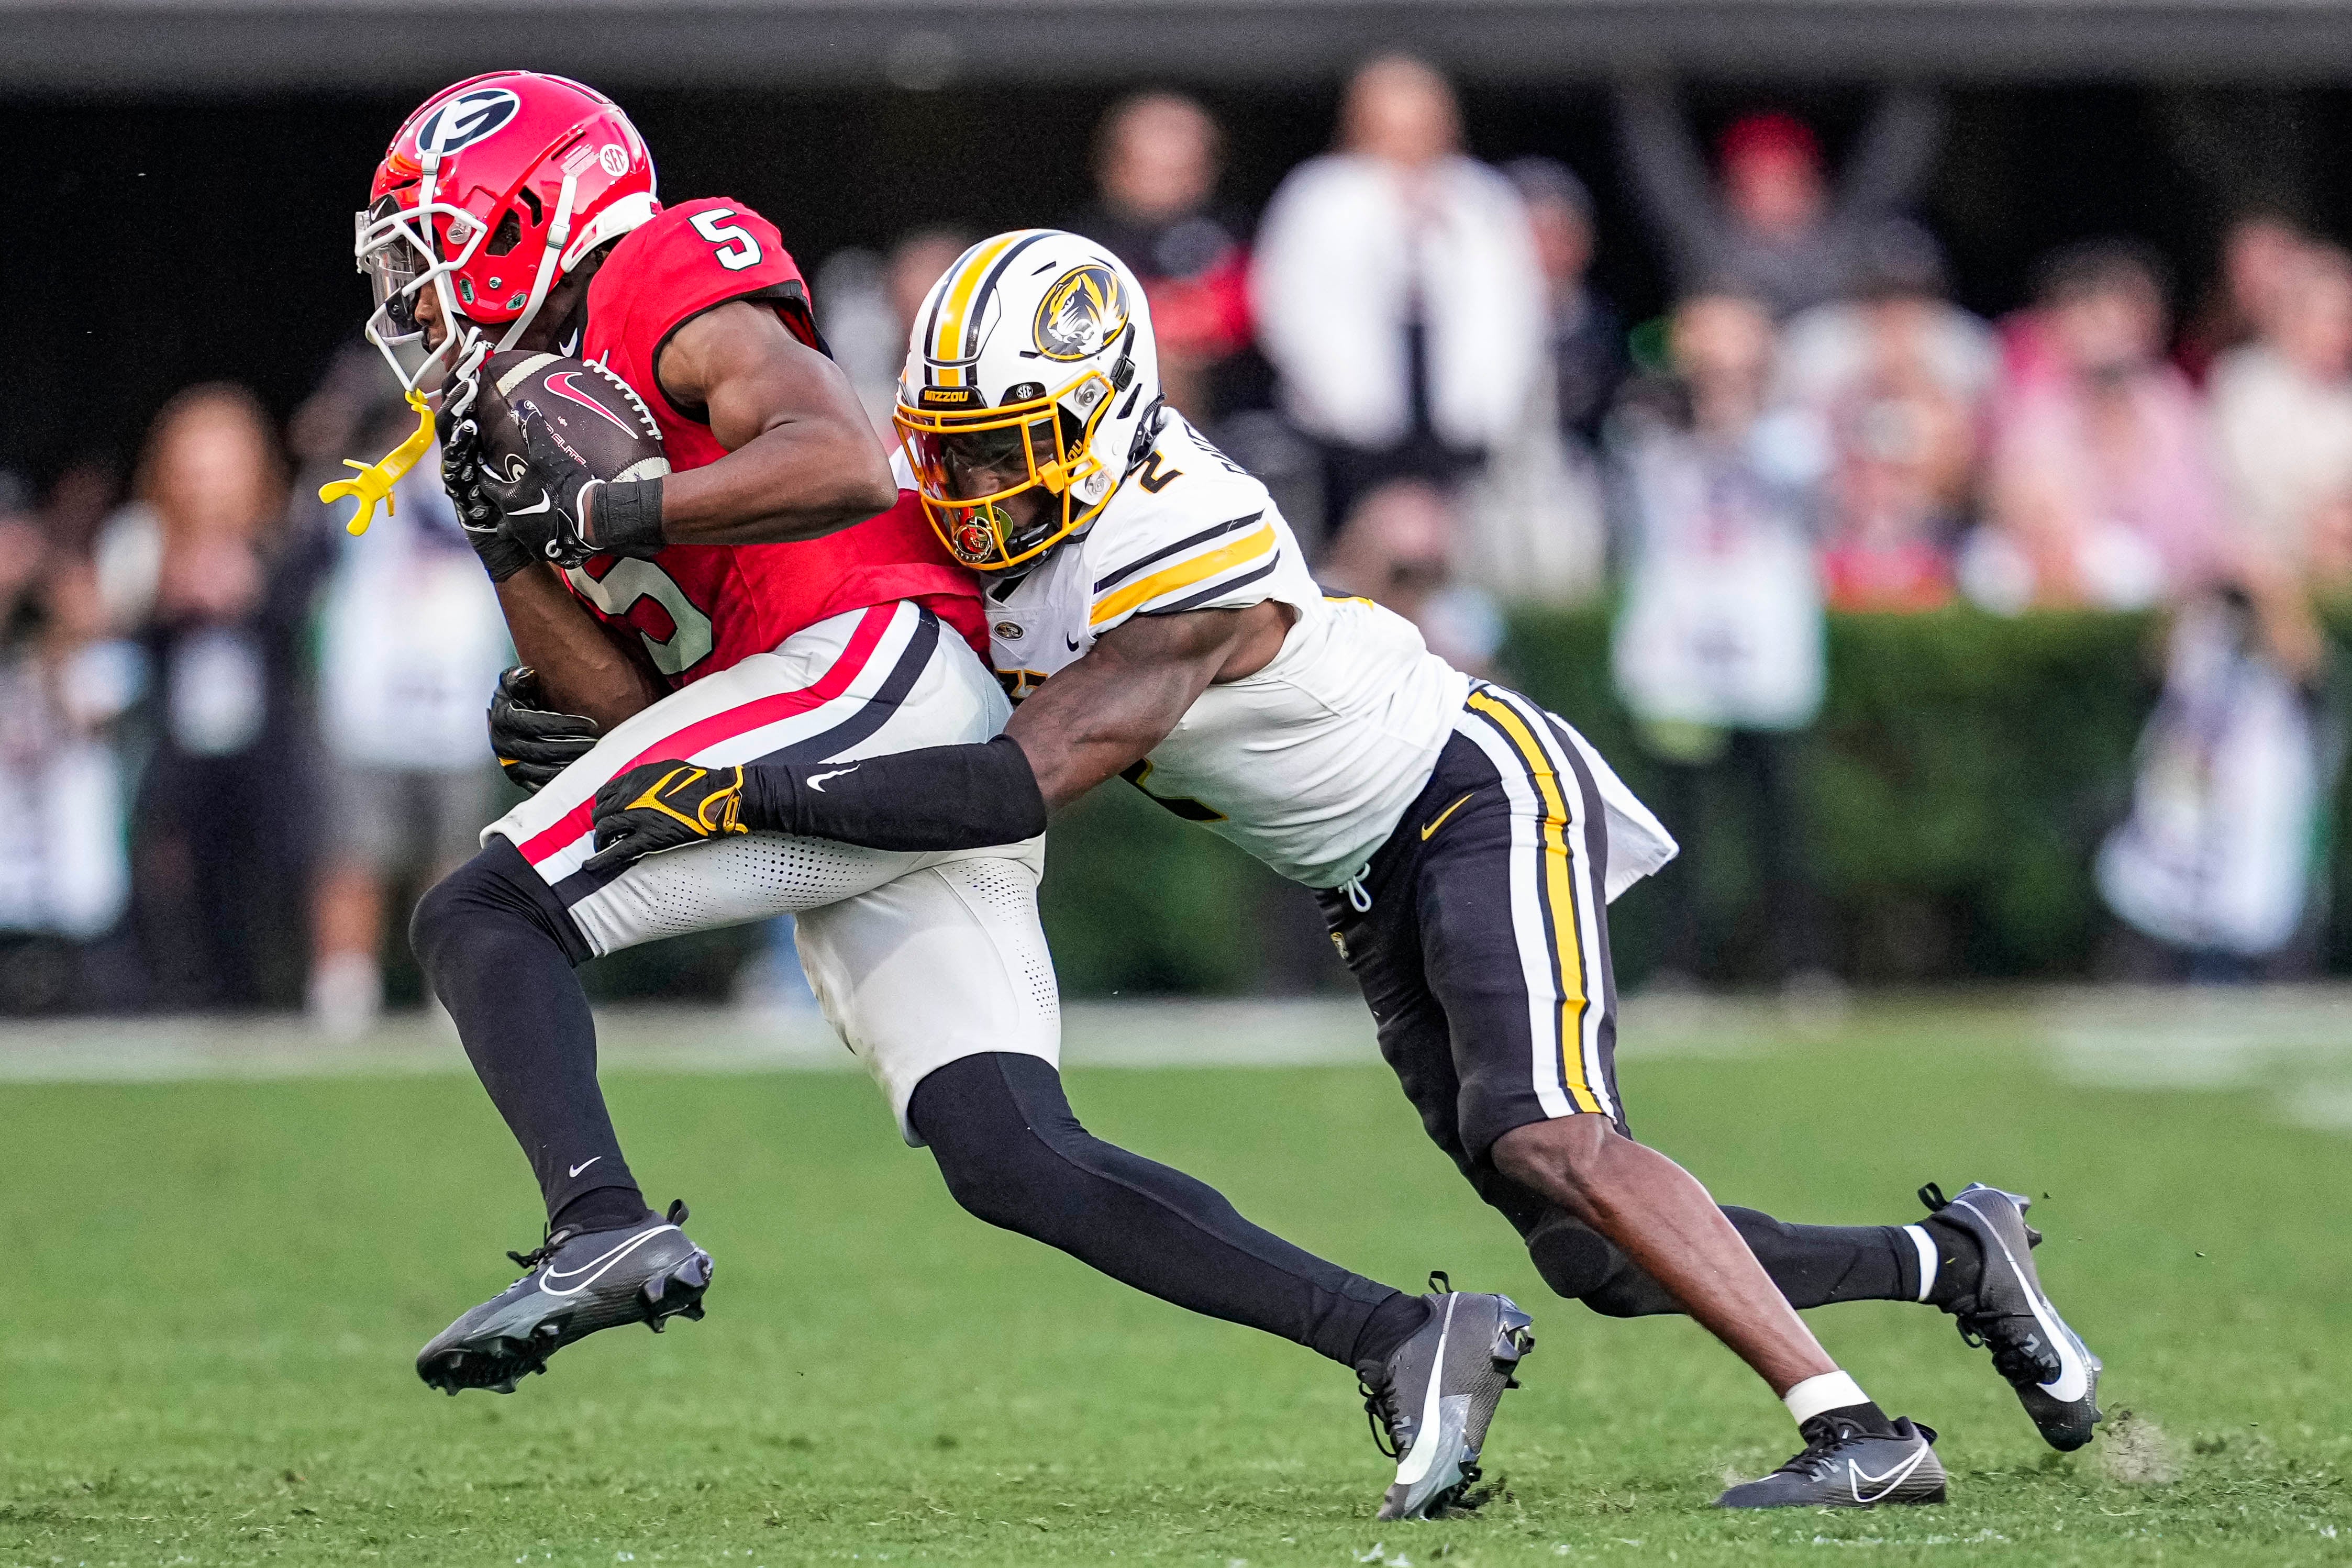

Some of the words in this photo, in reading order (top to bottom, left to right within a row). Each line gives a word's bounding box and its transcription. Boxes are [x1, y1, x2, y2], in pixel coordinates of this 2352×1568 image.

[422, 90, 519, 155] G
[603, 147, 627, 173] SEC
[686, 207, 763, 272] 5
[924, 390, 969, 402] MIZZOU
[1017, 384, 1033, 399] SEC
[1127, 449, 1185, 494] 2
[564, 556, 713, 675] 5
